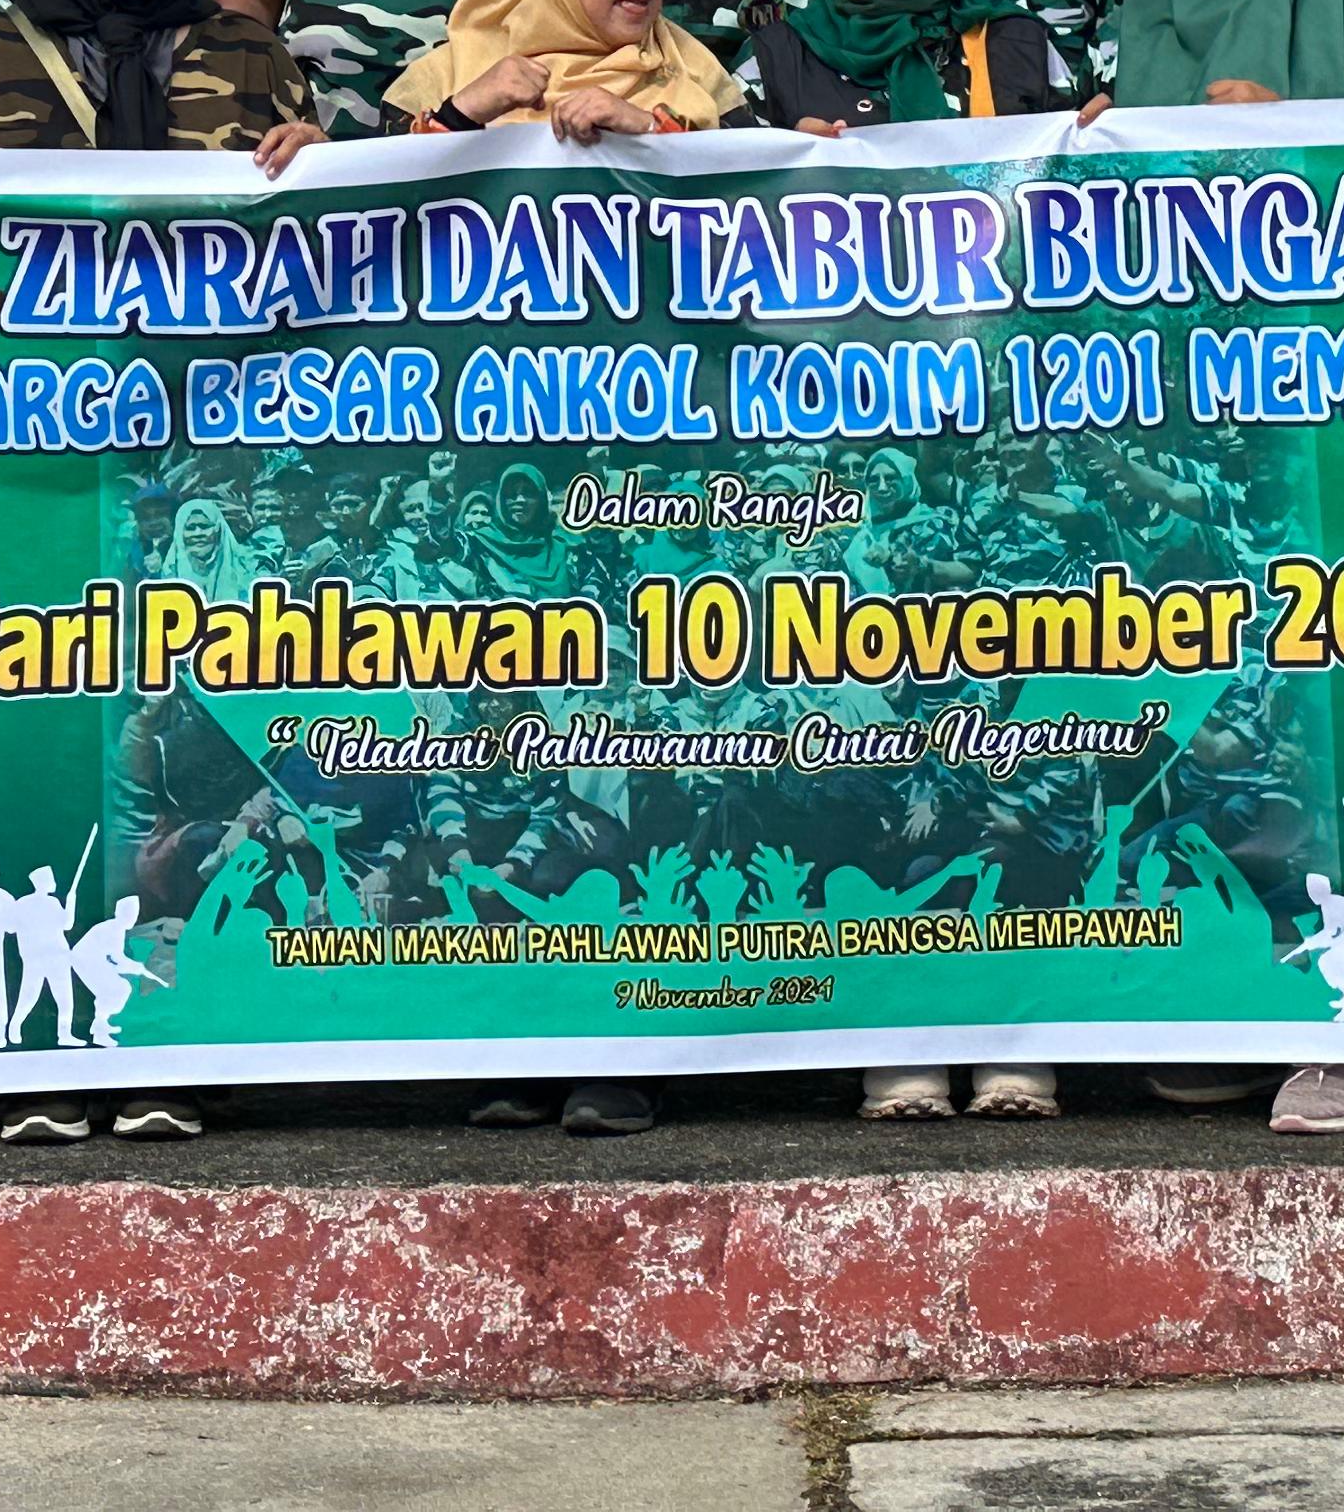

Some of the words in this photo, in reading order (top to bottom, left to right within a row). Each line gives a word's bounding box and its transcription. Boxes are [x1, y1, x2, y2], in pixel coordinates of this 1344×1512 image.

[2, 208, 406, 333] ZIARAH
[418, 194, 642, 322] DAN
[651, 189, 1013, 320] TABUR
[187, 345, 442, 445] BESAR
[457, 343, 717, 443] ANKOL
[730, 337, 987, 439] KODIM
[1006, 329, 1160, 435] 1201
[564, 472, 698, 527] Dalam
[707, 473, 862, 544] Rangka
[136, 578, 609, 699] Pahlawan
[629, 572, 752, 692] 10
[762, 561, 1256, 689] November
[308, 716, 496, 778] Teladani
[504, 714, 784, 775] Pahlawanmu
[791, 710, 922, 772] Cintai
[268, 927, 383, 965] TAMAN
[393, 925, 518, 964] MAKAM
[526, 923, 710, 963] PAHLAWAN
[718, 920, 833, 961] PUTRA
[838, 913, 980, 955] BANGSA
[987, 907, 1182, 951] MEMPAWAH
[614, 980, 635, 1009] 9
[636, 976, 765, 1010] November
